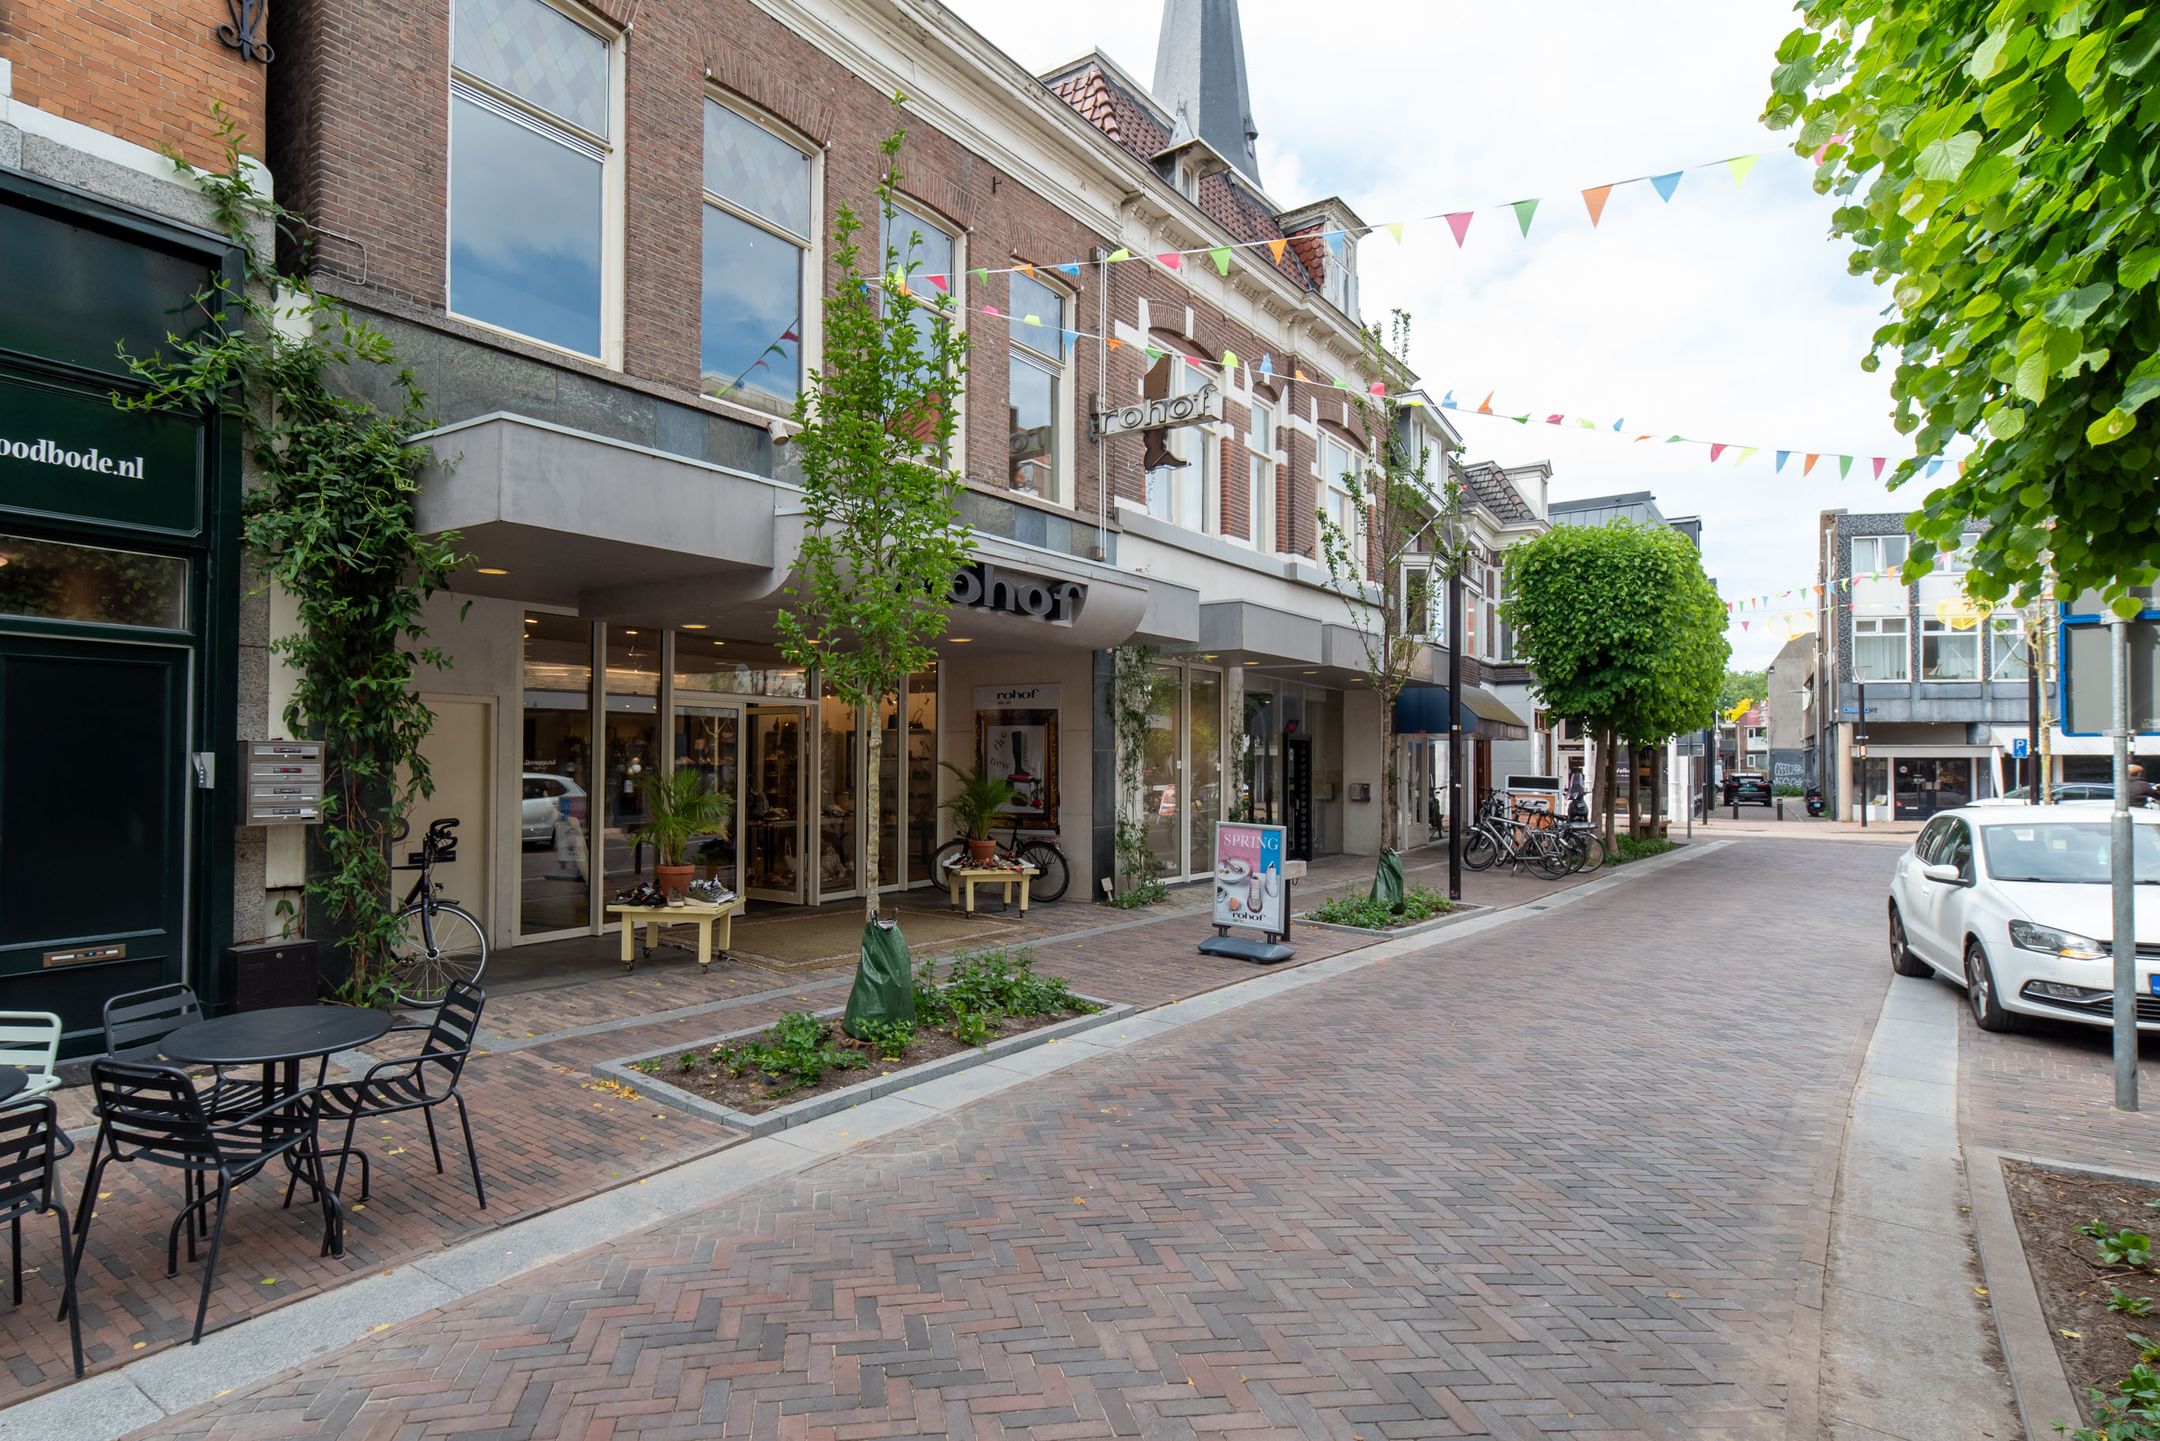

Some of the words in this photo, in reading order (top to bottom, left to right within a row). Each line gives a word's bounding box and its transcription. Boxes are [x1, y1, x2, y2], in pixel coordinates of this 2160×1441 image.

[1100, 384, 1218, 434] rohof
[944, 563, 1084, 620] ohof
[996, 688, 1040, 700] rohof
[2016, 740, 2025, 750] P
[990, 757, 1010, 770] new
[1223, 834, 1279, 851] SPRING
[1232, 912, 1266, 921] rohof
